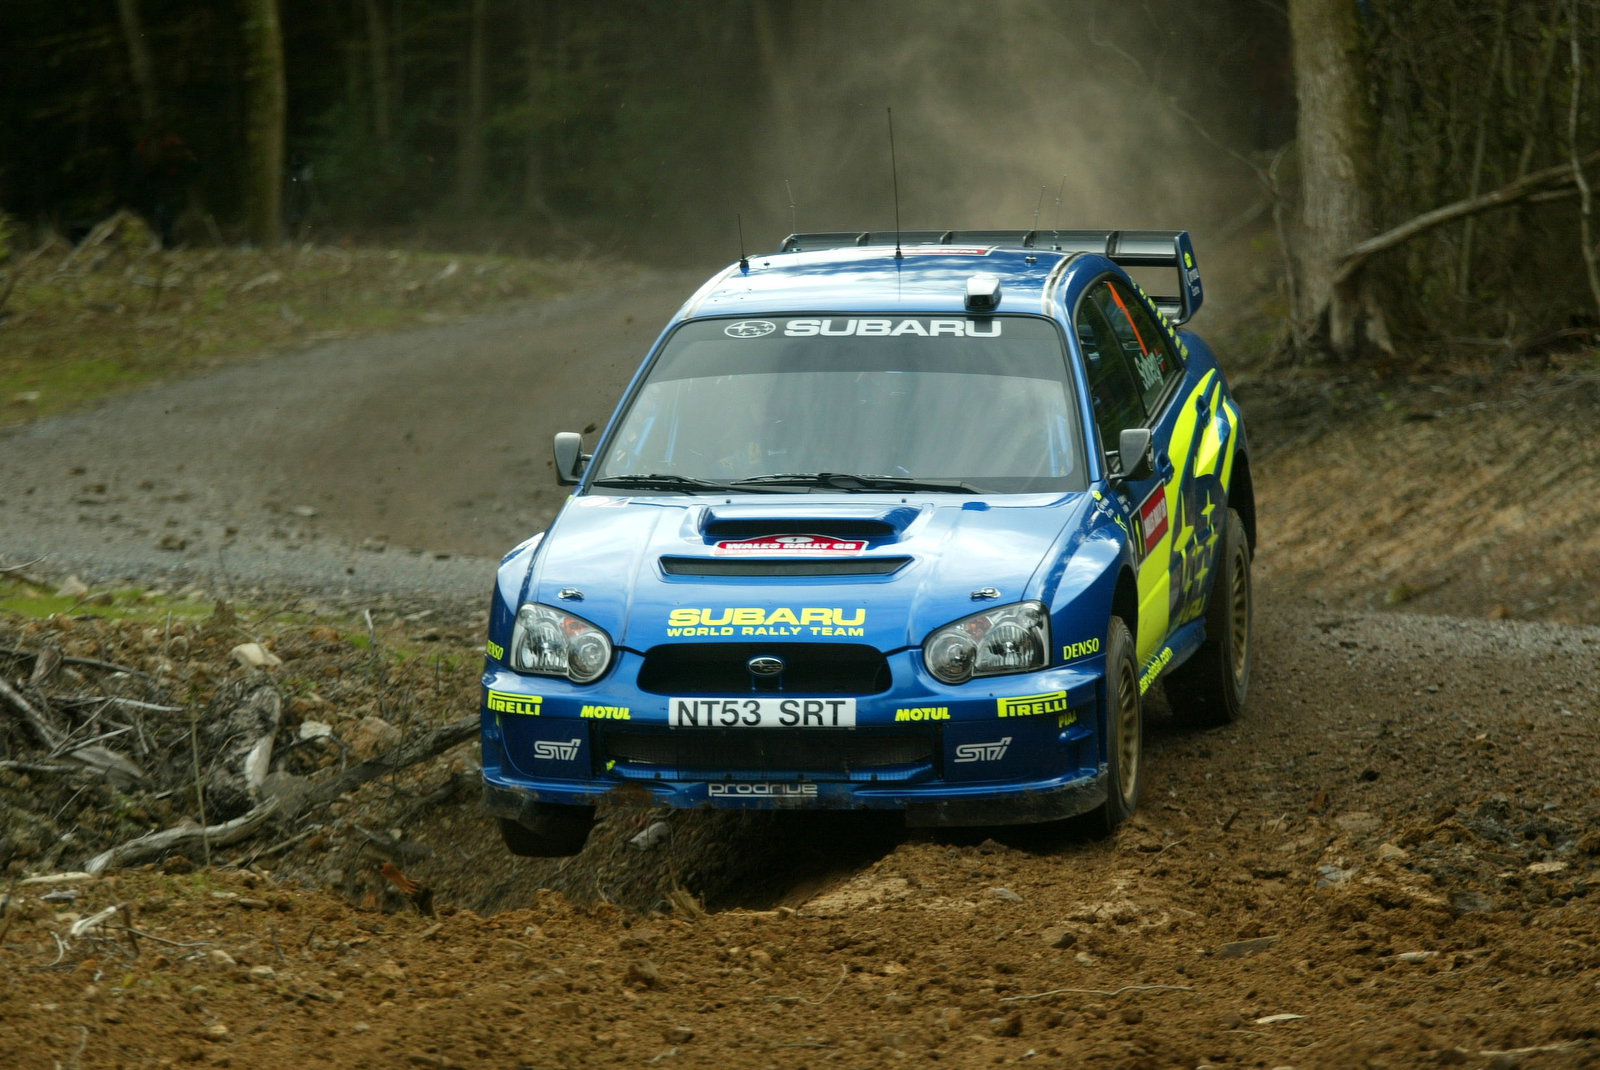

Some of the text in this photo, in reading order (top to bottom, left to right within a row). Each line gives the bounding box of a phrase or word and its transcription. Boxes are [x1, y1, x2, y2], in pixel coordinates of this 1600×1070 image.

[784, 319, 1001, 337] SUBARU
[668, 607, 866, 627] SUBARU
[667, 627, 865, 637] WORLD RALLY TEAM
[1063, 638, 1100, 660] DENSO
[487, 689, 543, 716] PIRELLI
[997, 690, 1067, 717] PIRELLI
[580, 705, 631, 720] MOTUL
[678, 700, 846, 727] NT53 SRT
[895, 707, 951, 721] MOTUL
[708, 783, 818, 797] prodrive
